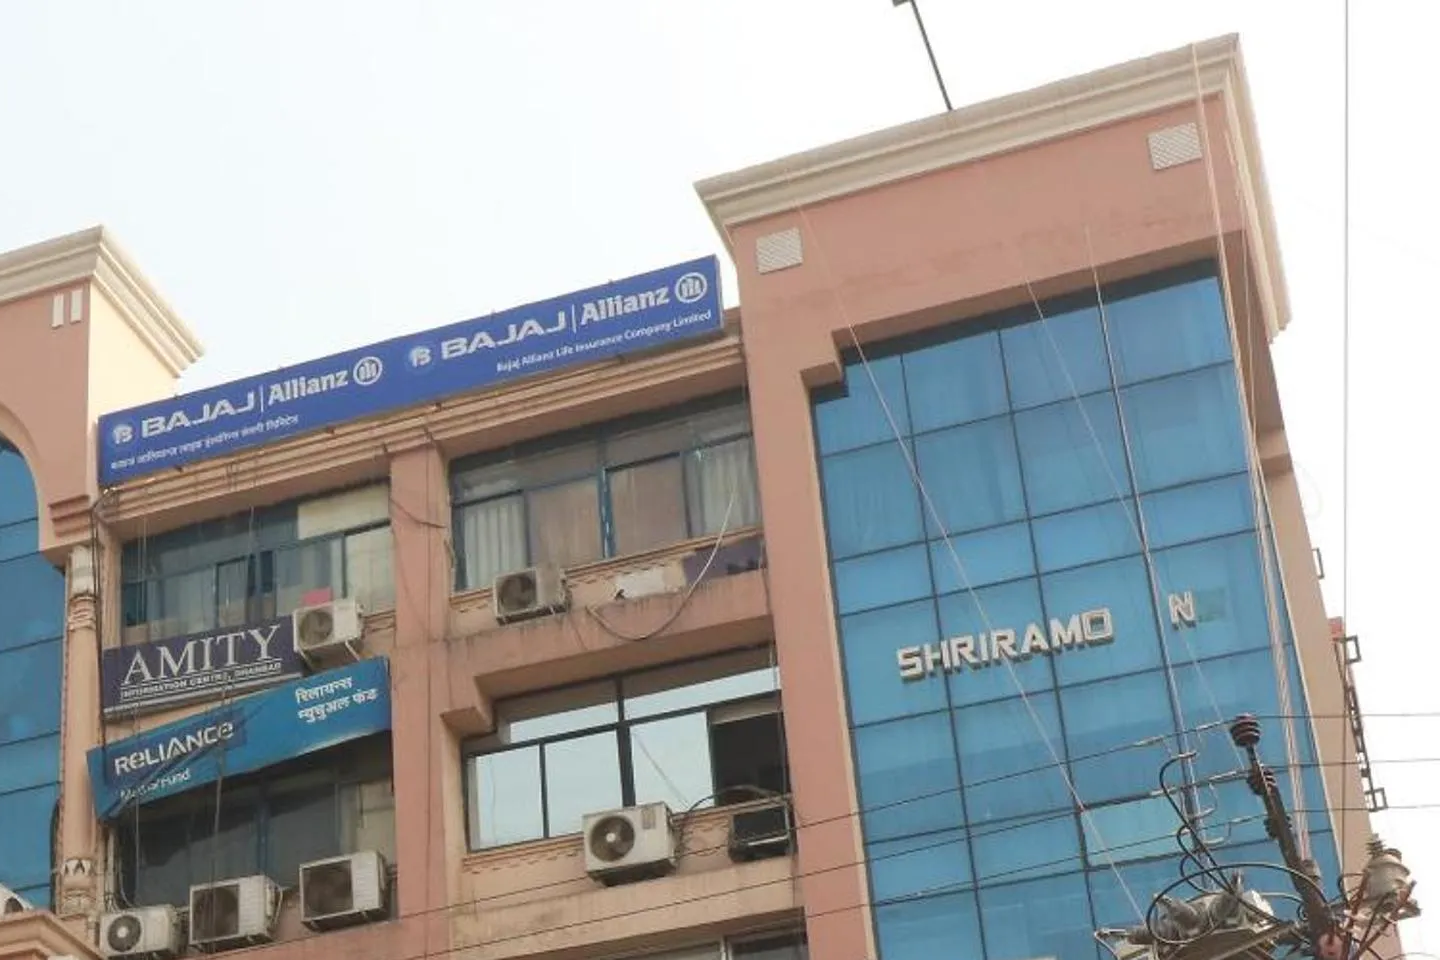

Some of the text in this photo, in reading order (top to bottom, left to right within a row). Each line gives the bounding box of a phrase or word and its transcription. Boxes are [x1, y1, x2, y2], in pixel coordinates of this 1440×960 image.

[441, 310, 566, 361] BAJAJ
[581, 284, 670, 325] Allianz
[673, 309, 712, 329] Limited
[141, 392, 255, 438] BAJAJ
[268, 369, 349, 406] Allianz
[122, 623, 283, 687] AMITY
